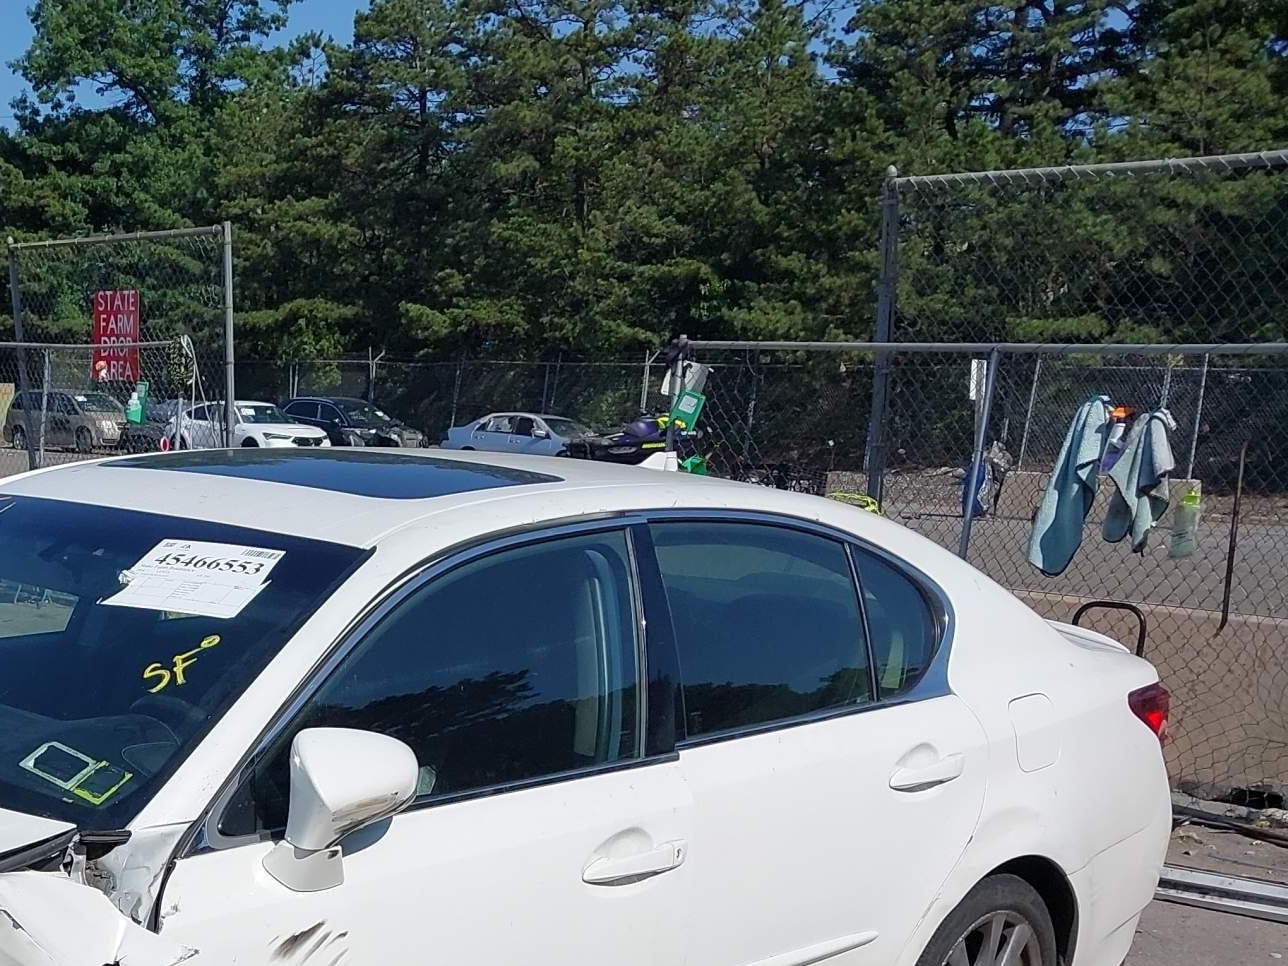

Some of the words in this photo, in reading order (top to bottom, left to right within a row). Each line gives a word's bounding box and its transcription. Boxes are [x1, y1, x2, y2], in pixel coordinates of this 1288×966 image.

[97, 290, 136, 312] STATE
[100, 313, 134, 335] FARM
[100, 336, 133, 357] DROP
[154, 552, 265, 576] 45466553
